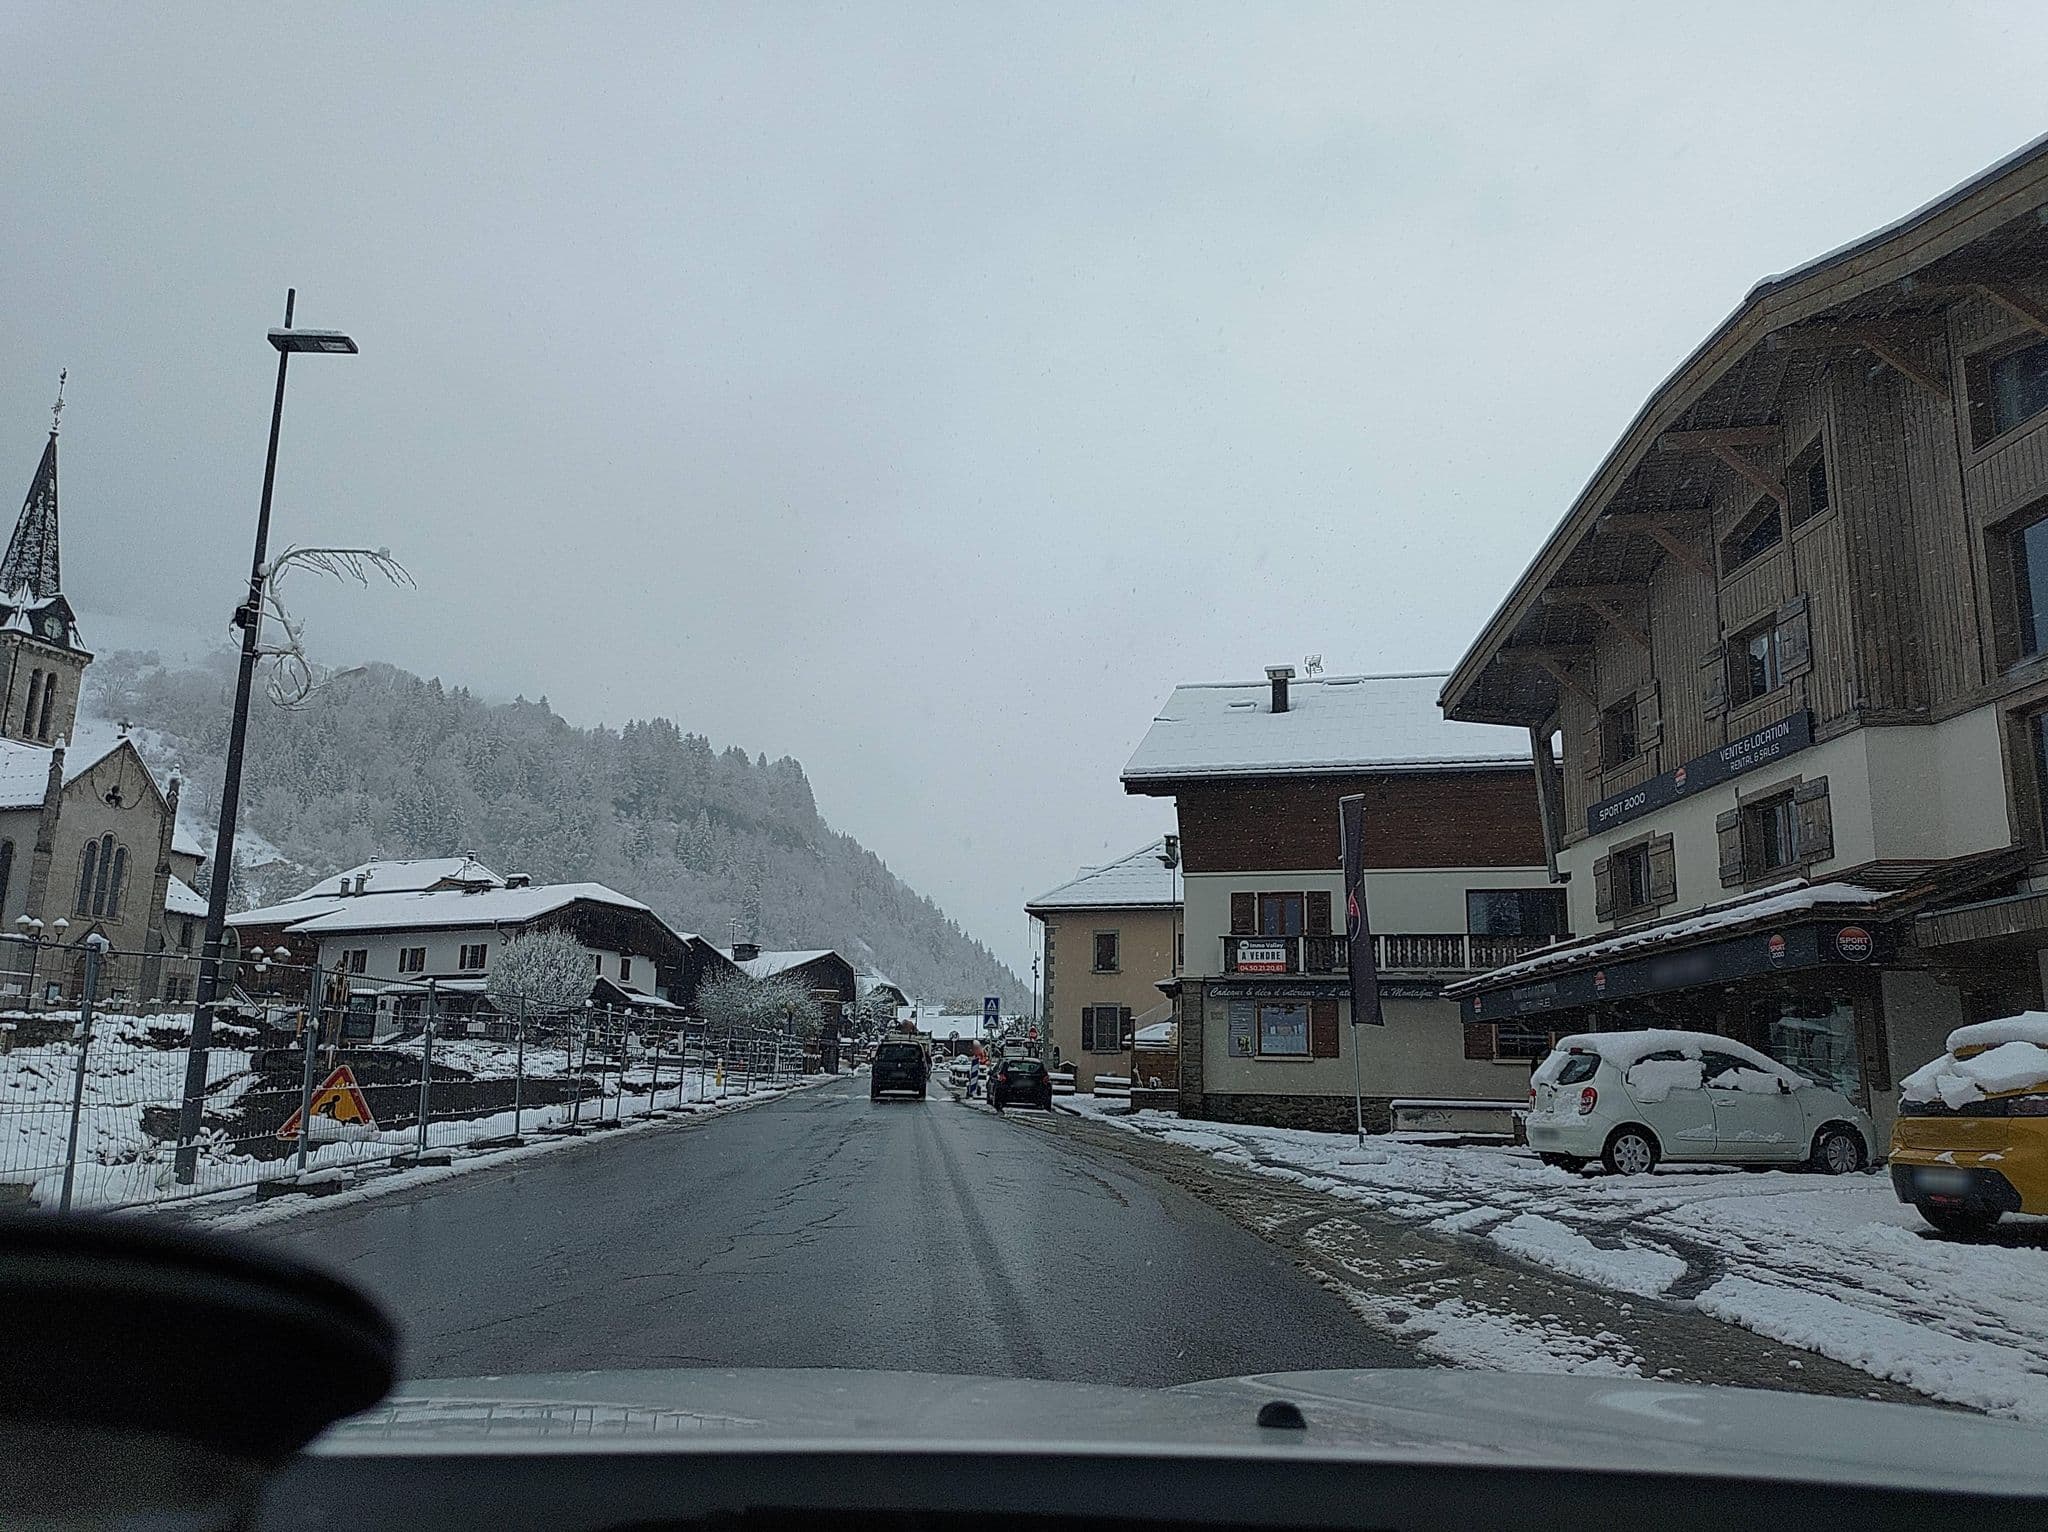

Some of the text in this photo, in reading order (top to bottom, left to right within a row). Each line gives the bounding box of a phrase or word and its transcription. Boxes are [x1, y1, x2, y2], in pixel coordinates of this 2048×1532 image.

[1719, 742, 1744, 762] VENTE
[1750, 720, 1789, 749] LOCATION
[1729, 755, 1754, 773] RENTAL
[1759, 743, 1780, 761] SALES
[1599, 792, 1646, 821] SPORT 2000
[1839, 936, 1869, 944] SPORT
[1241, 951, 1281, 960] A VENDRE
